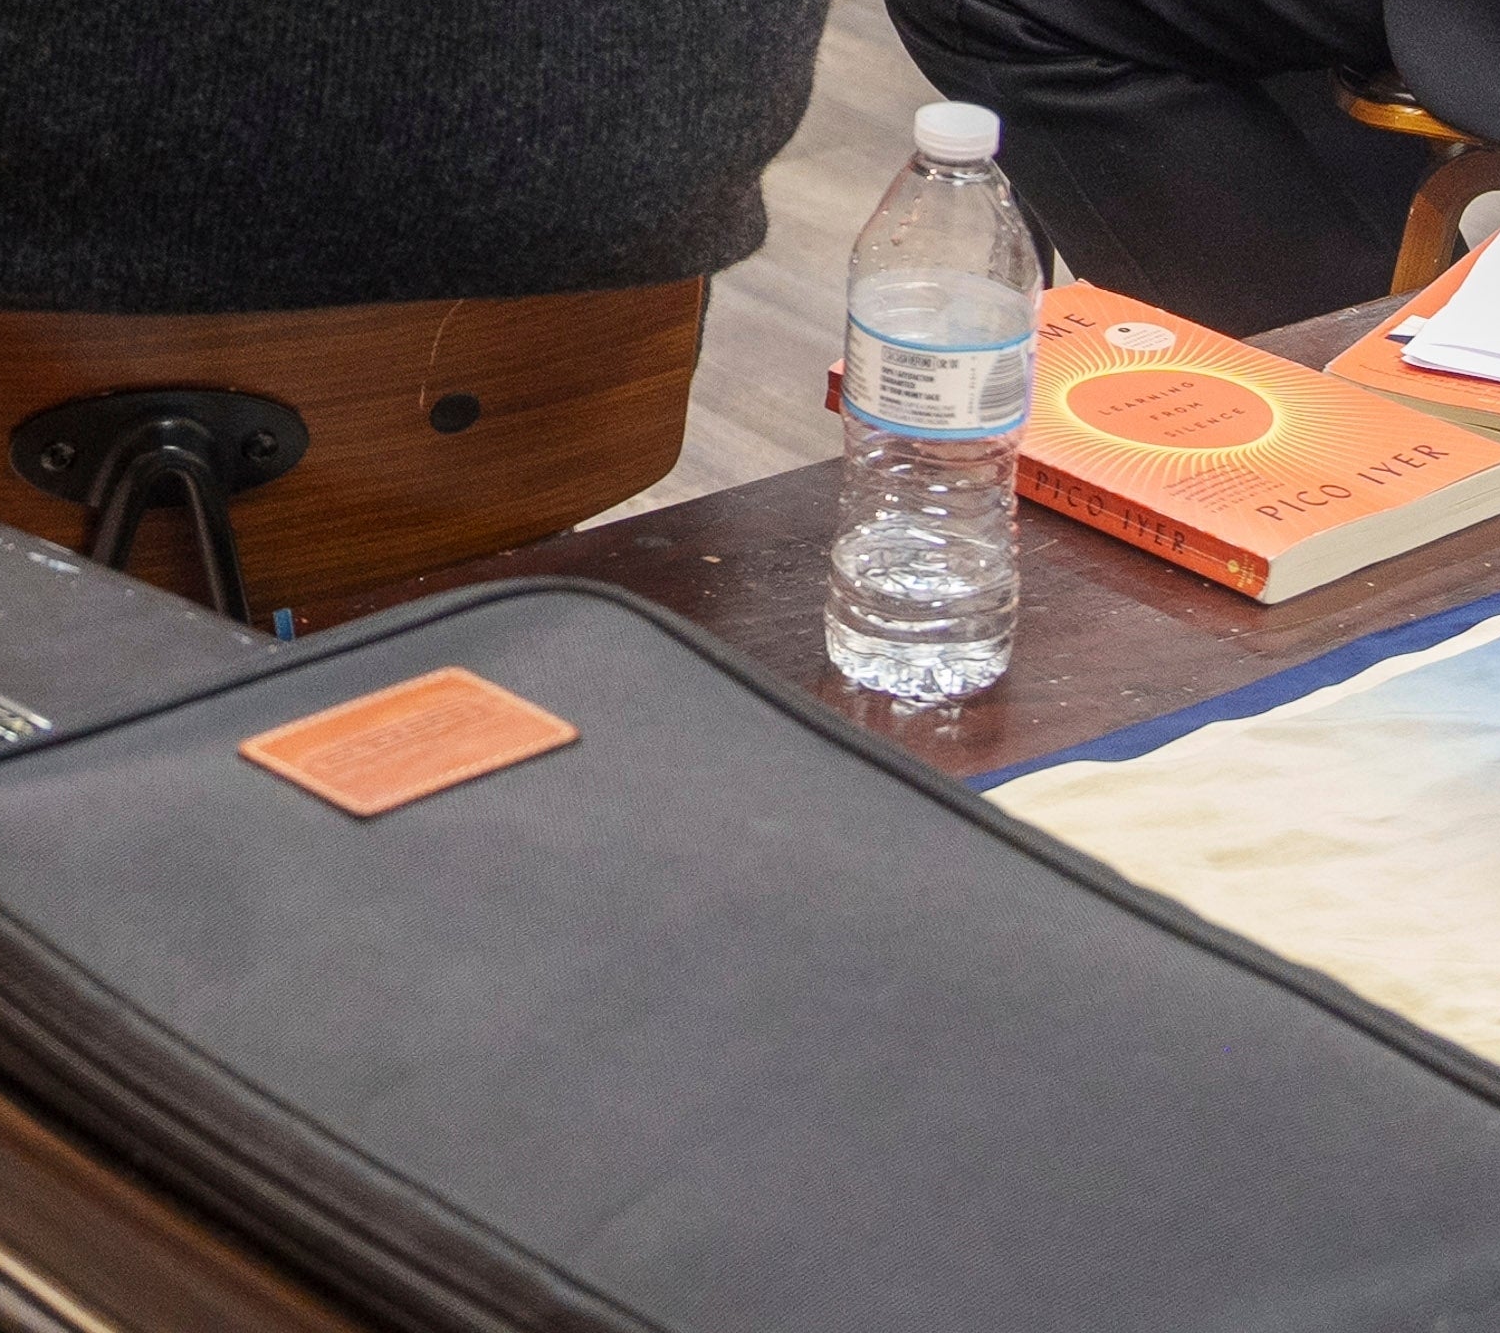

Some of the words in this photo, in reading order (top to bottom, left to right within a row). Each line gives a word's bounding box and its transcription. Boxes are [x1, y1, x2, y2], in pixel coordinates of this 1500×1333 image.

[1098, 381, 1195, 416] LEARNING
[1150, 402, 1204, 421] FROM
[1164, 407, 1245, 438] SILENCE
[1255, 484, 1352, 521] PICO
[1357, 444, 1450, 485] IYER
[1035, 470, 1105, 517] PICO
[1122, 508, 1187, 555] IYER
